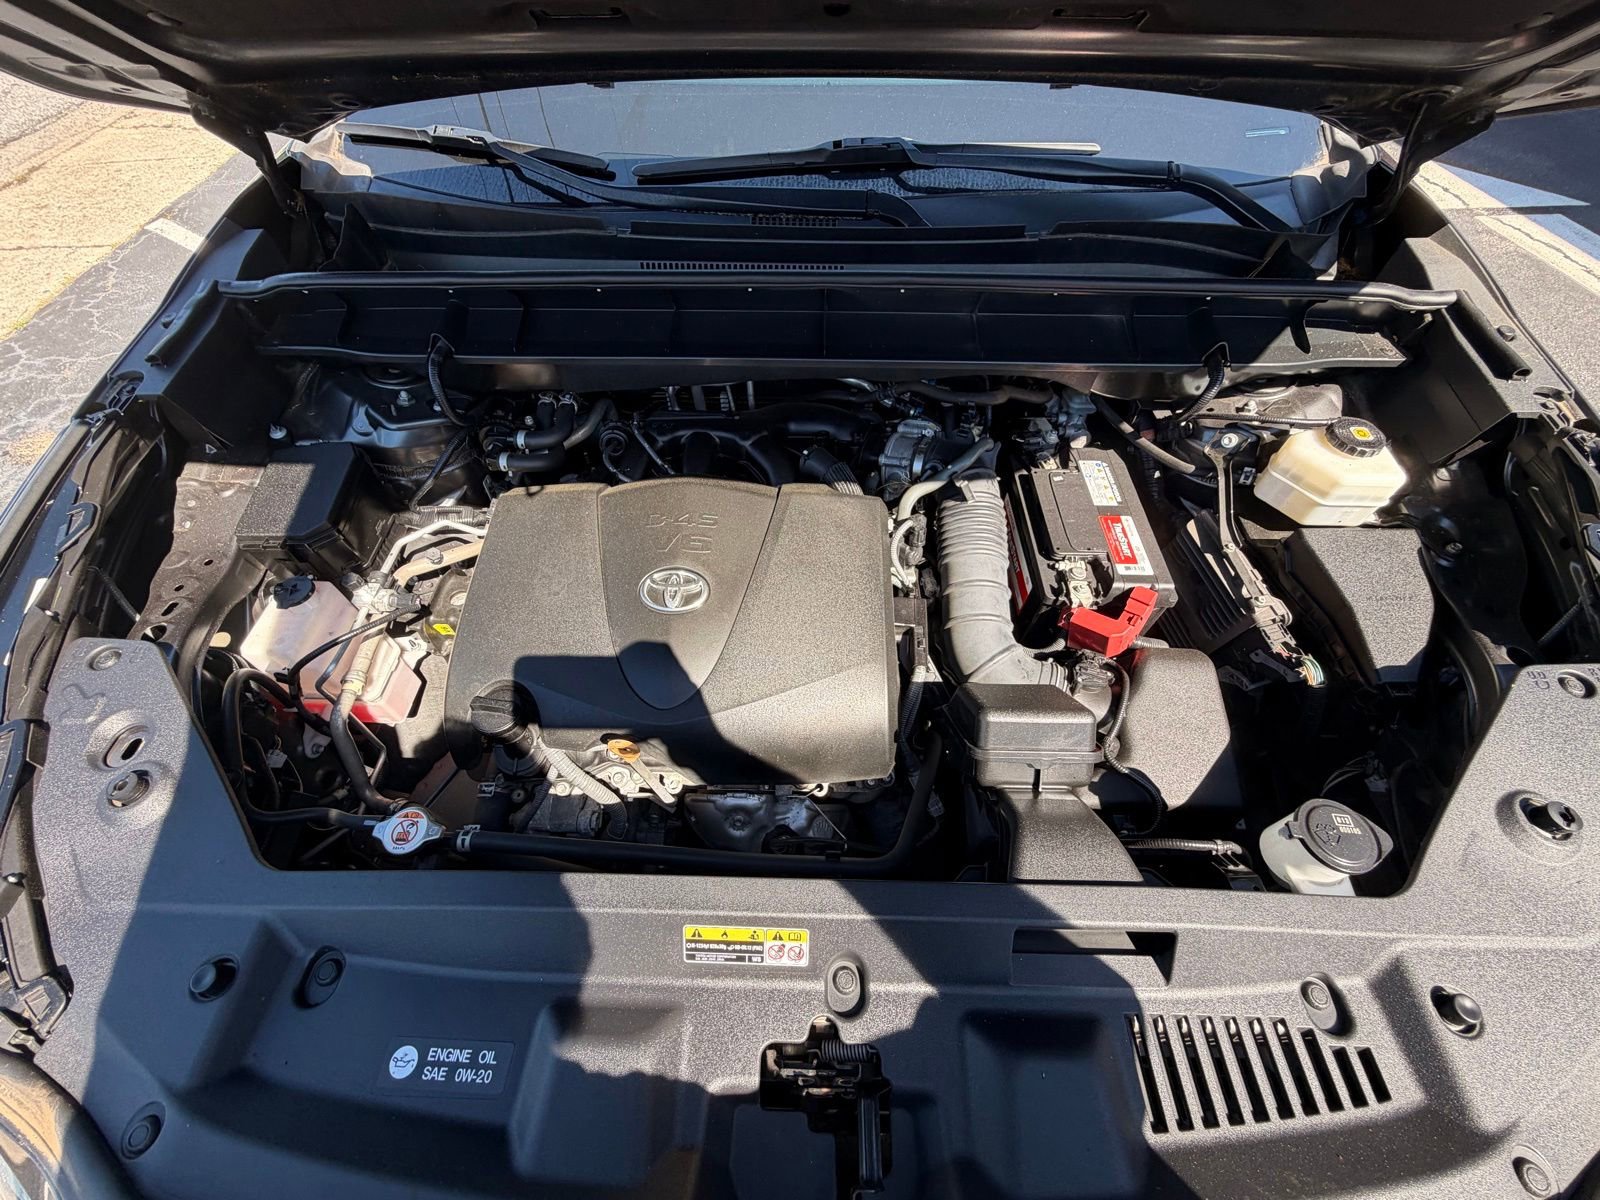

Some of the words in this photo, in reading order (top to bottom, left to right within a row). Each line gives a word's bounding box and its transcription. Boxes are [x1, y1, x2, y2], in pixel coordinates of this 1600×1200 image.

[427, 1047, 472, 1063] ENGINE
[478, 1050, 497, 1065] OIL
[421, 1066, 448, 1081] SAE
[454, 1068, 493, 1084] 0W-20
